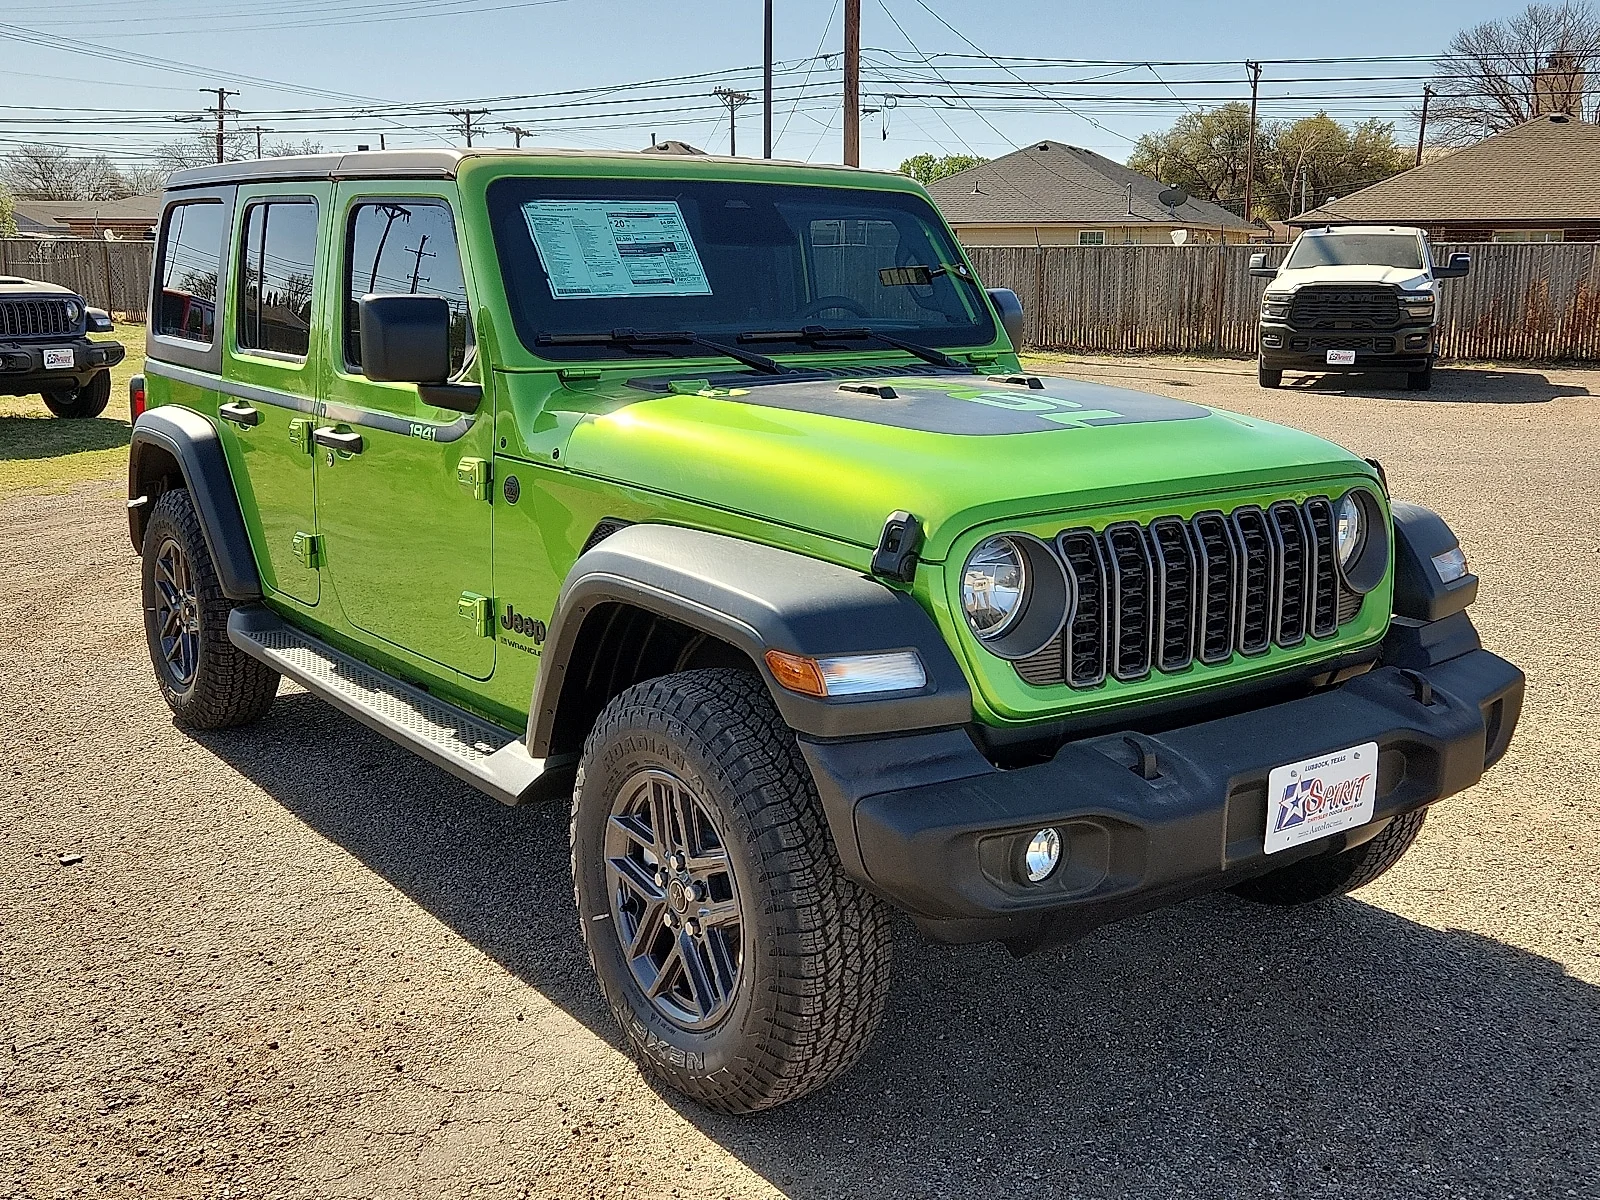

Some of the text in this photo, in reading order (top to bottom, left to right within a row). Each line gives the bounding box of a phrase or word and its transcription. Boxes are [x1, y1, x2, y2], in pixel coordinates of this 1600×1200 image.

[614, 219, 625, 228] 20
[410, 423, 437, 441] 1941
[501, 604, 546, 645] Jeep
[508, 639, 543, 657] WRANGLE
[1331, 755, 1346, 765] TEXAS
[1306, 774, 1372, 813] SPIRIT
